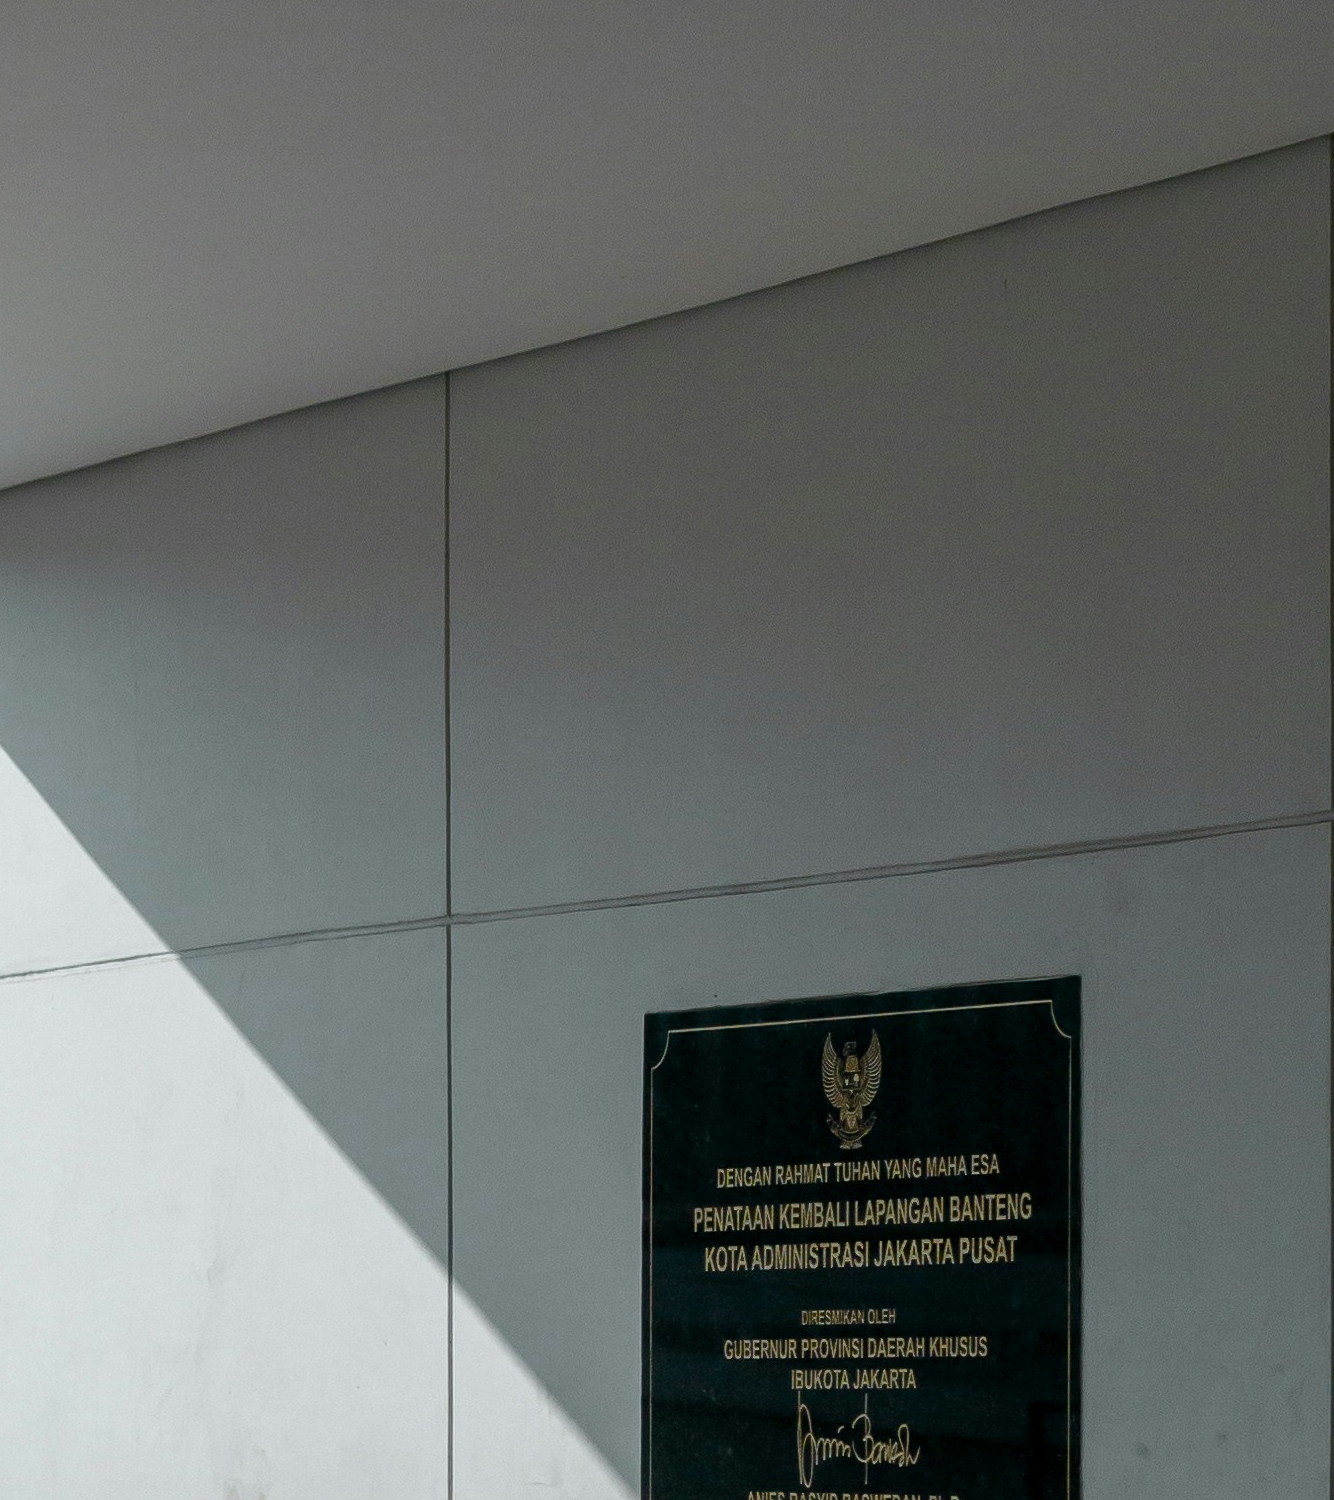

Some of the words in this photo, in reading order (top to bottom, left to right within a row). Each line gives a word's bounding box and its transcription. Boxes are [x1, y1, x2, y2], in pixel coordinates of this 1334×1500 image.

[717, 1167, 772, 1188] DENGAN
[775, 1162, 831, 1185] RAHMAT
[834, 1160, 880, 1182] TUHAN
[884, 1157, 922, 1180] YANG
[926, 1155, 968, 1177] MAHA
[971, 1153, 1000, 1175] ESA
[694, 1204, 775, 1233] PENATAAN
[779, 1200, 850, 1230] KEMBALI
[854, 1196, 944, 1226] LAPANGAN
[949, 1192, 1032, 1223] BANTENG
[705, 1244, 748, 1272] KOTA
[751, 1241, 869, 1271] ADMINISTRASI
[873, 1238, 955, 1267] JAKARTA
[959, 1235, 1018, 1264] PUSAT
[801, 1309, 865, 1325] DIRESMIKAN
[867, 1308, 896, 1324] OLEH
[723, 1339, 798, 1360] GUBERNUR
[801, 1337, 864, 1359] PROVINSI
[867, 1336, 925, 1358] DAERAH
[929, 1335, 988, 1357] KHUSUS
[791, 1369, 851, 1390] IBUKOTA
[853, 1368, 917, 1389] JAKARTA
